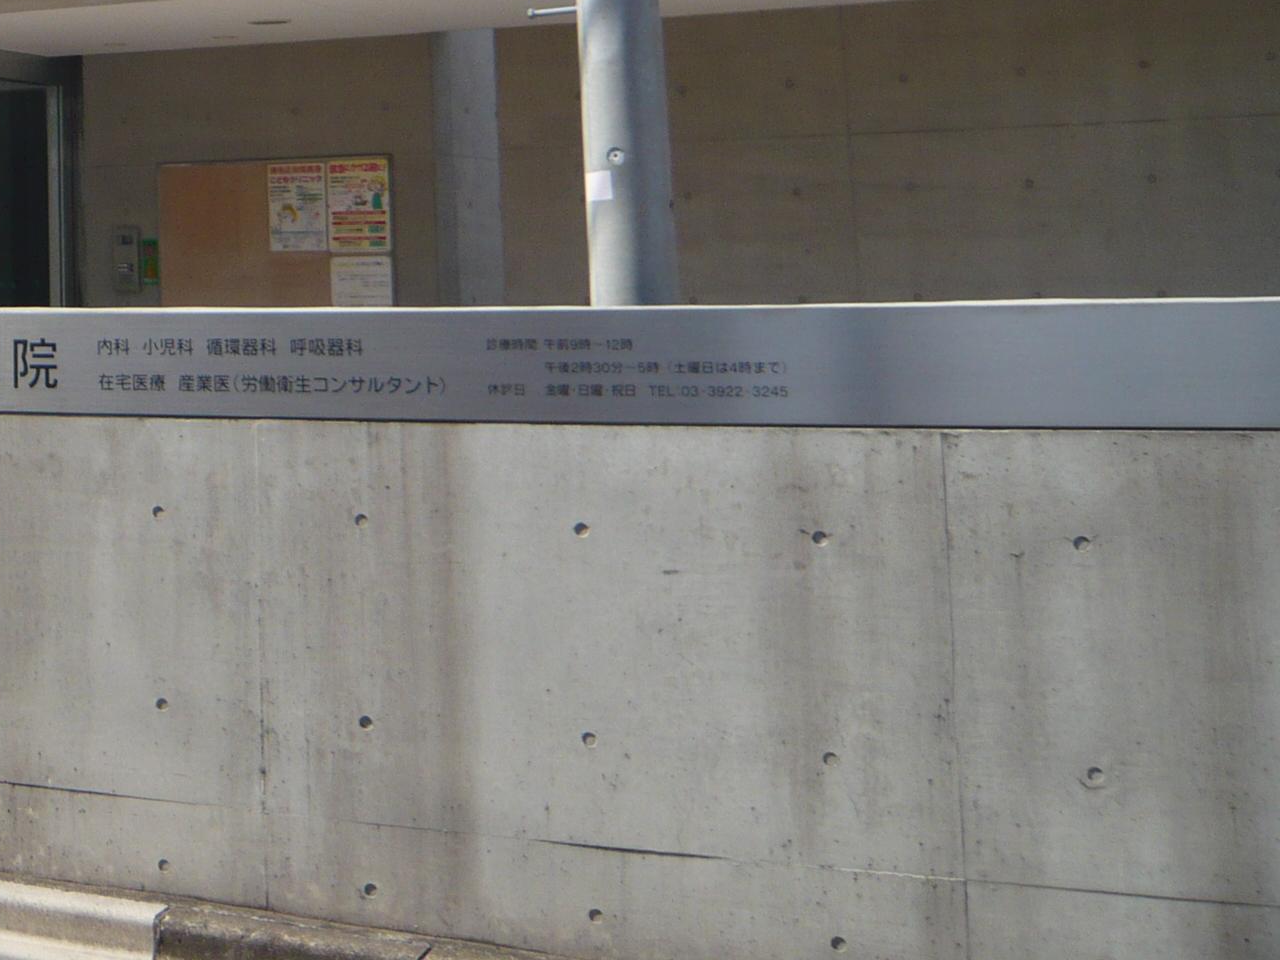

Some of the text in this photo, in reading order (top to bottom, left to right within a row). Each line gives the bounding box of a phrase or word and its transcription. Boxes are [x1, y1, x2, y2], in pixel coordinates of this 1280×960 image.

[97, 338, 364, 356] 内科 小児科 循環器科 呼吸器科
[98, 374, 166, 392] 在宅医療
